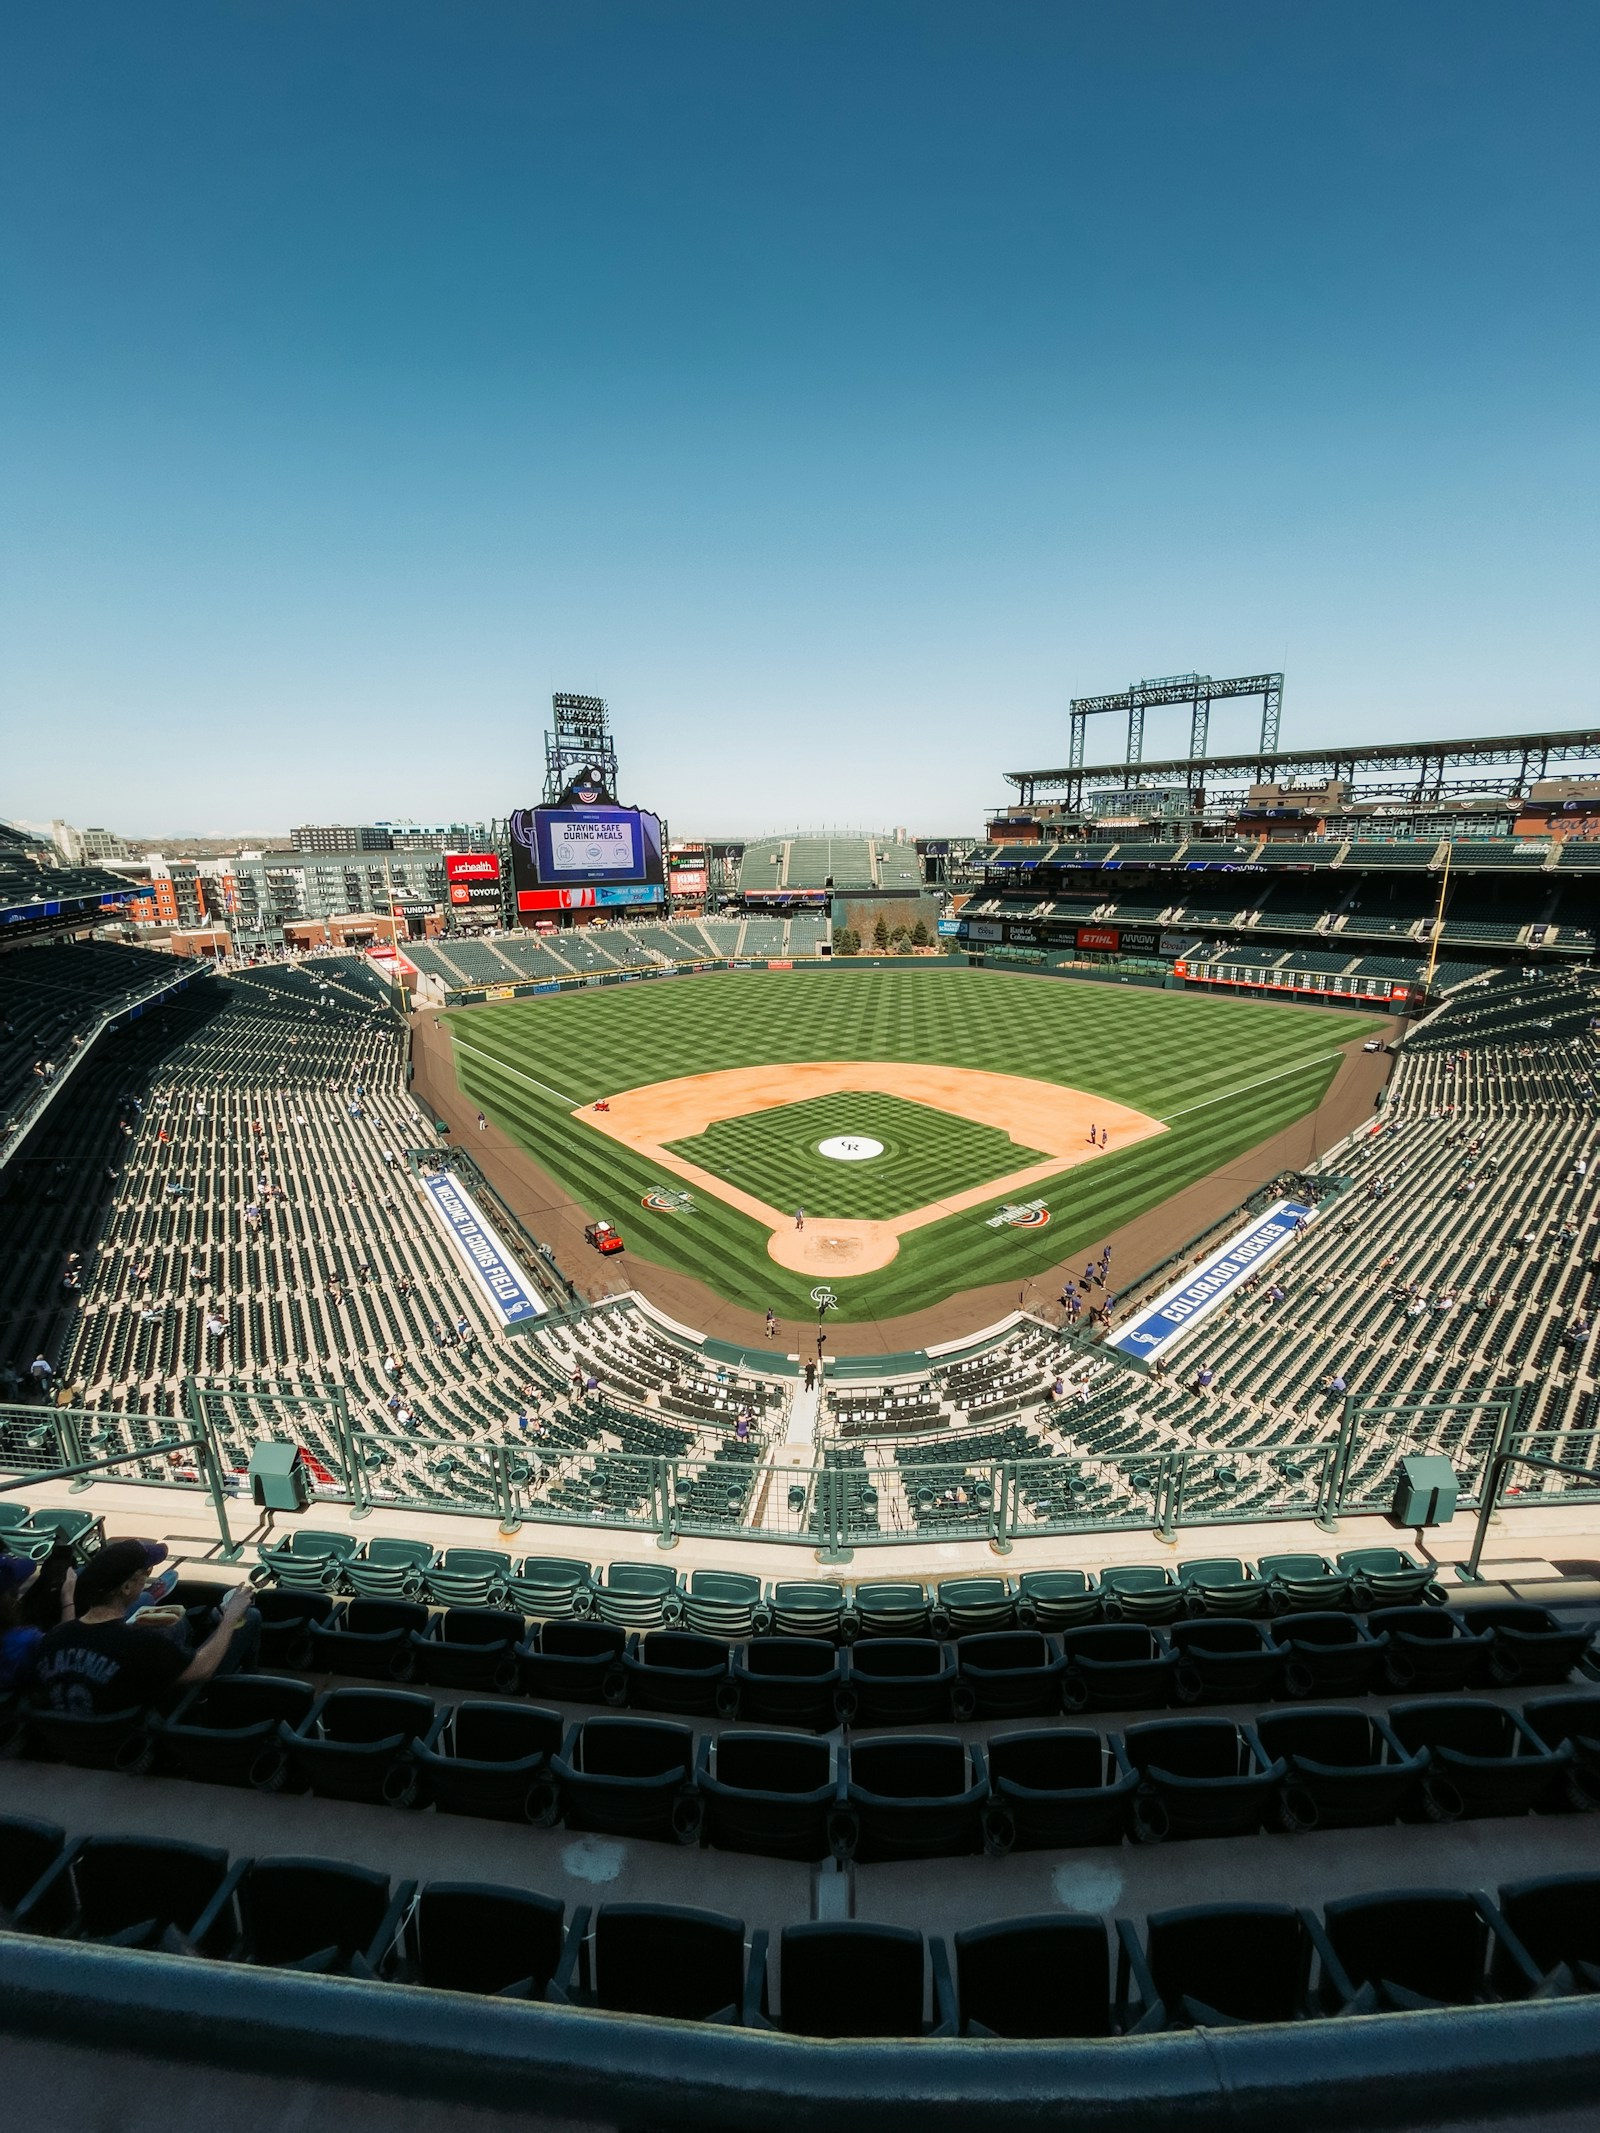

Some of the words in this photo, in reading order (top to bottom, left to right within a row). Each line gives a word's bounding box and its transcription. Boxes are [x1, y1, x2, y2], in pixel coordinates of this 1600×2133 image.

[567, 824, 599, 832] STAYING
[1096, 821, 1139, 829] SMASHBURGER
[563, 832, 594, 840] DURING
[596, 832, 622, 840] MEALS
[455, 861, 492, 872] uchealth
[469, 888, 500, 897] TOYOTA
[403, 905, 434, 914] TUNDRA
[1024, 927, 1032, 935] of
[1010, 933, 1036, 942] Colorado
[1082, 934, 1113, 944] STIHL
[1122, 934, 1155, 944] ARROW
[434, 1184, 467, 1222] WELCOME
[457, 1221, 478, 1234] TO
[465, 1233, 499, 1267] COORS
[1161, 1262, 1240, 1322] COLORADO
[1230, 1223, 1286, 1264] ROCKIES
[484, 1266, 520, 1300] FIELD
